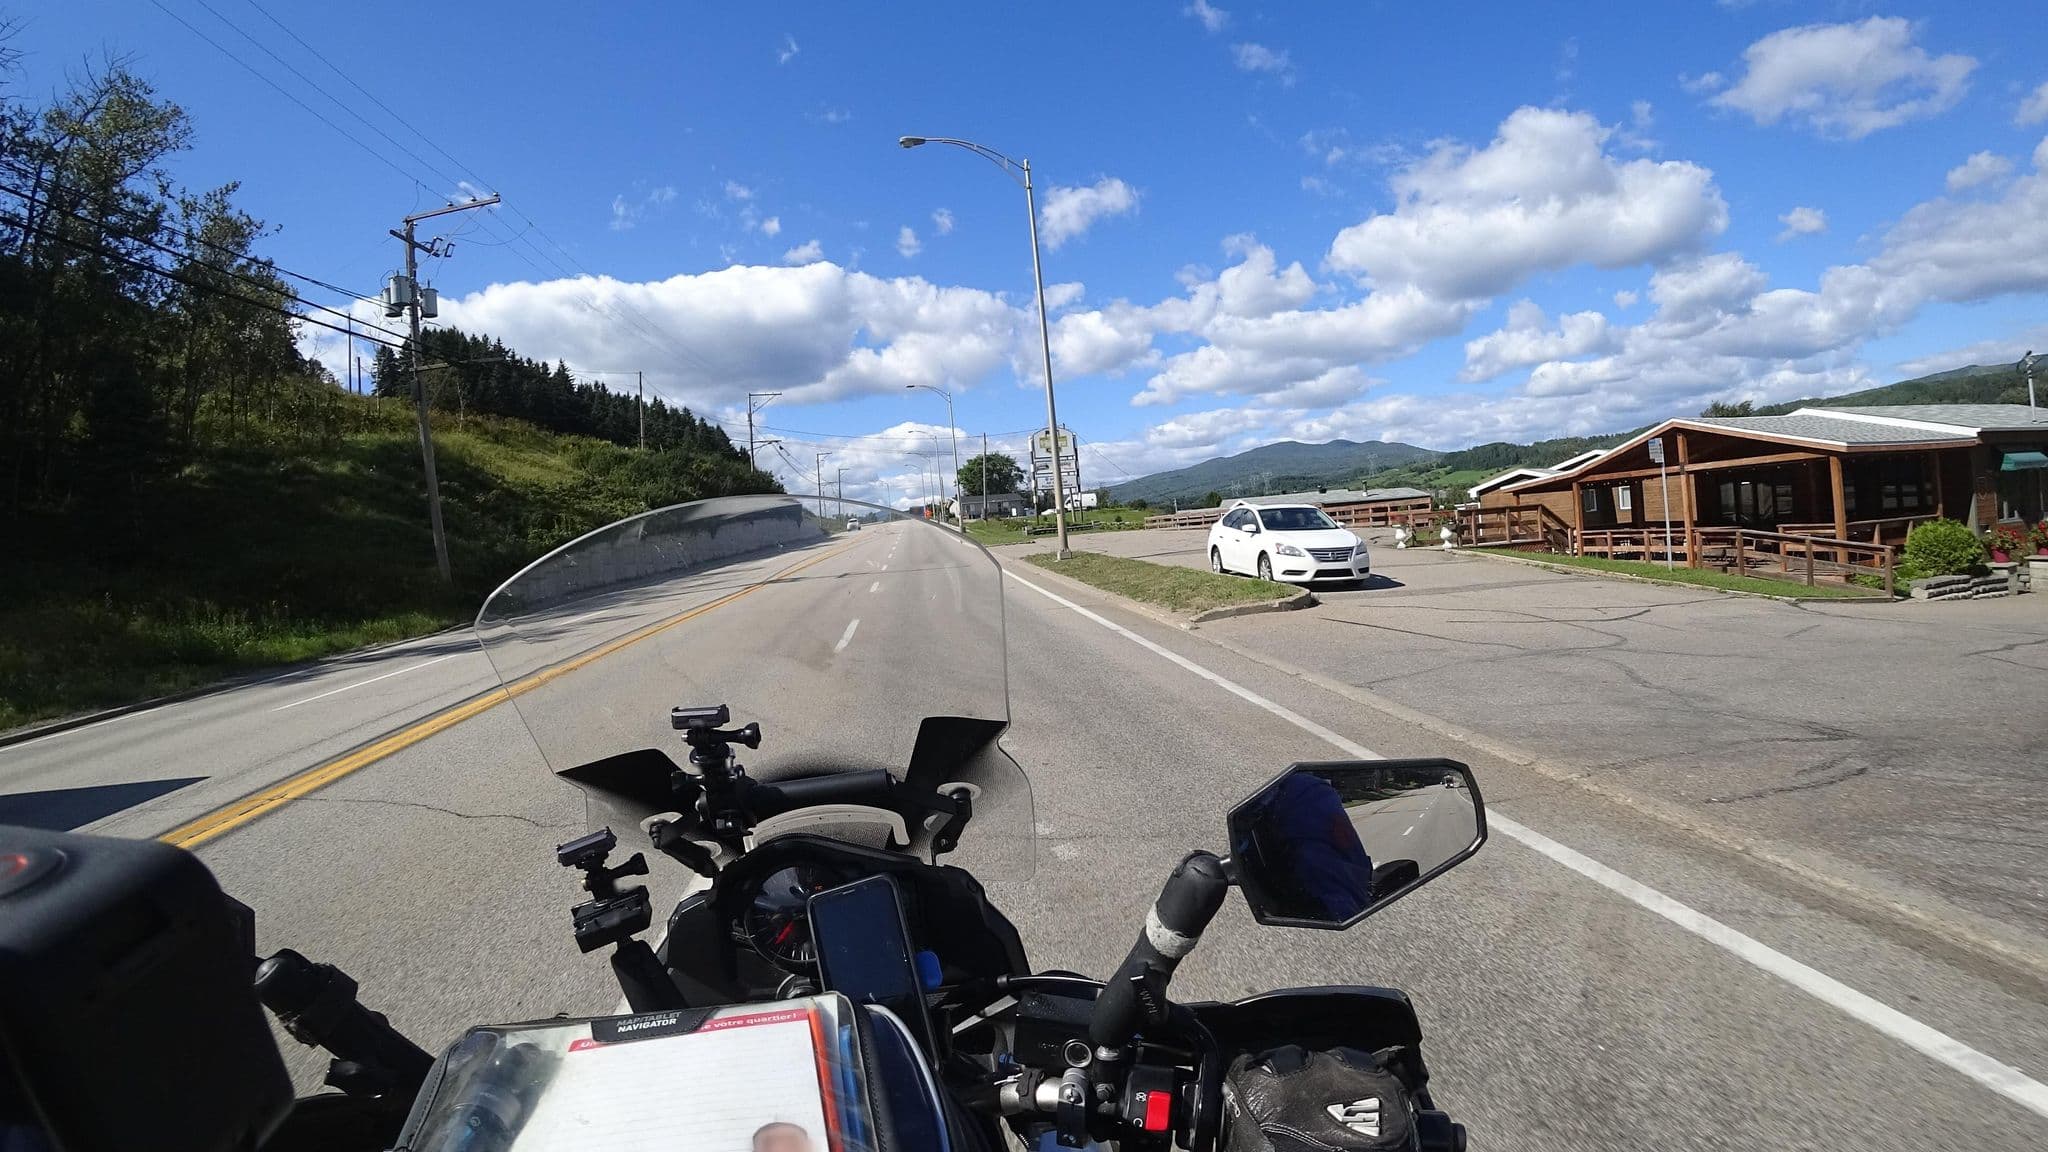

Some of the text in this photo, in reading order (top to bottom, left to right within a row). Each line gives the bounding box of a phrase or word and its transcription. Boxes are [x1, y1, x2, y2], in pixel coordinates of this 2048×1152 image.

[617, 1018, 677, 1033] NAVIGATOR
[714, 1019, 744, 1028] votre
[746, 1012, 797, 1024] quartier!
